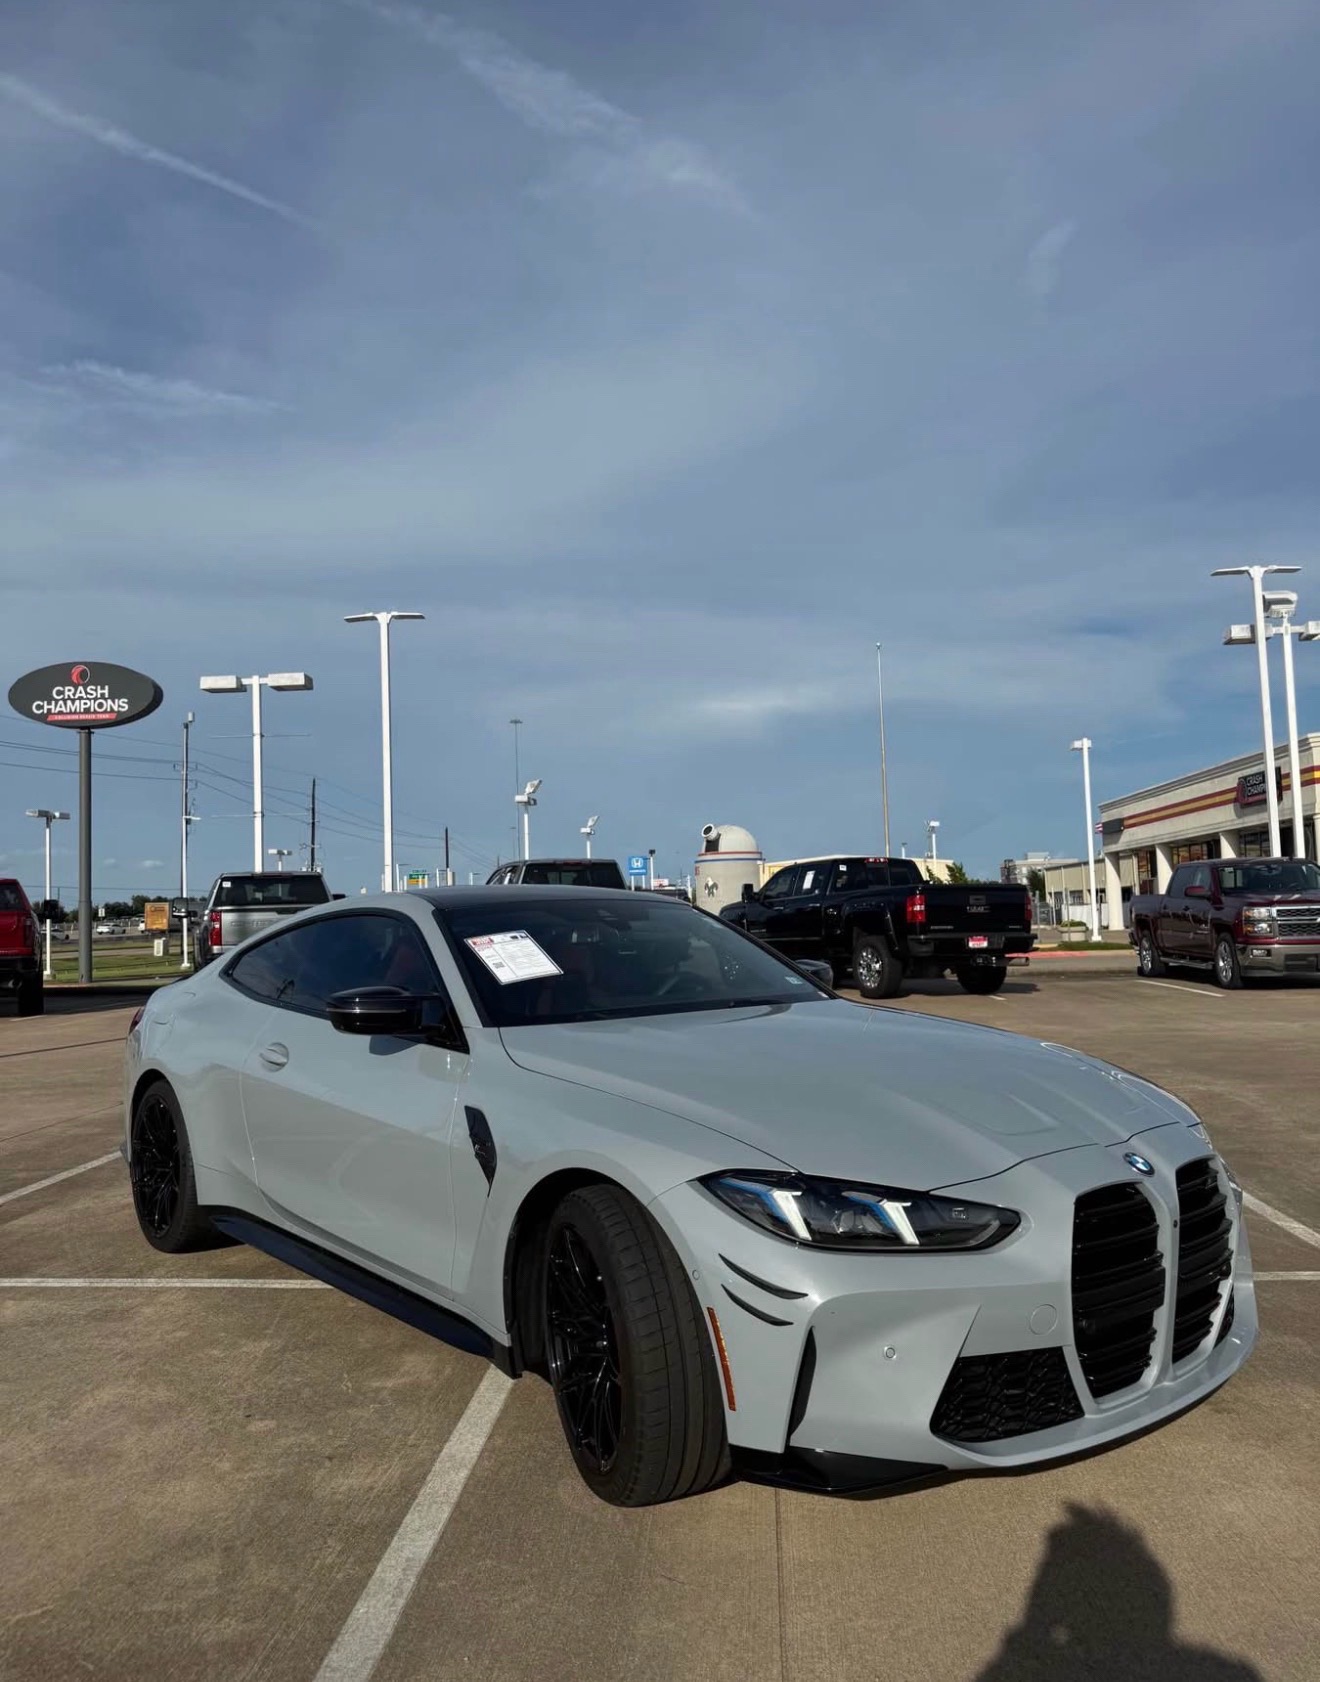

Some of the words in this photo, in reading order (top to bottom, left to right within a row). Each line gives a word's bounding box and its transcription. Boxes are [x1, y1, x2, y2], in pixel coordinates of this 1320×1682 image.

[52, 685, 109, 699] CRASH
[32, 698, 129, 714] CHAMPIONS
[1246, 774, 1263, 786] CRASH
